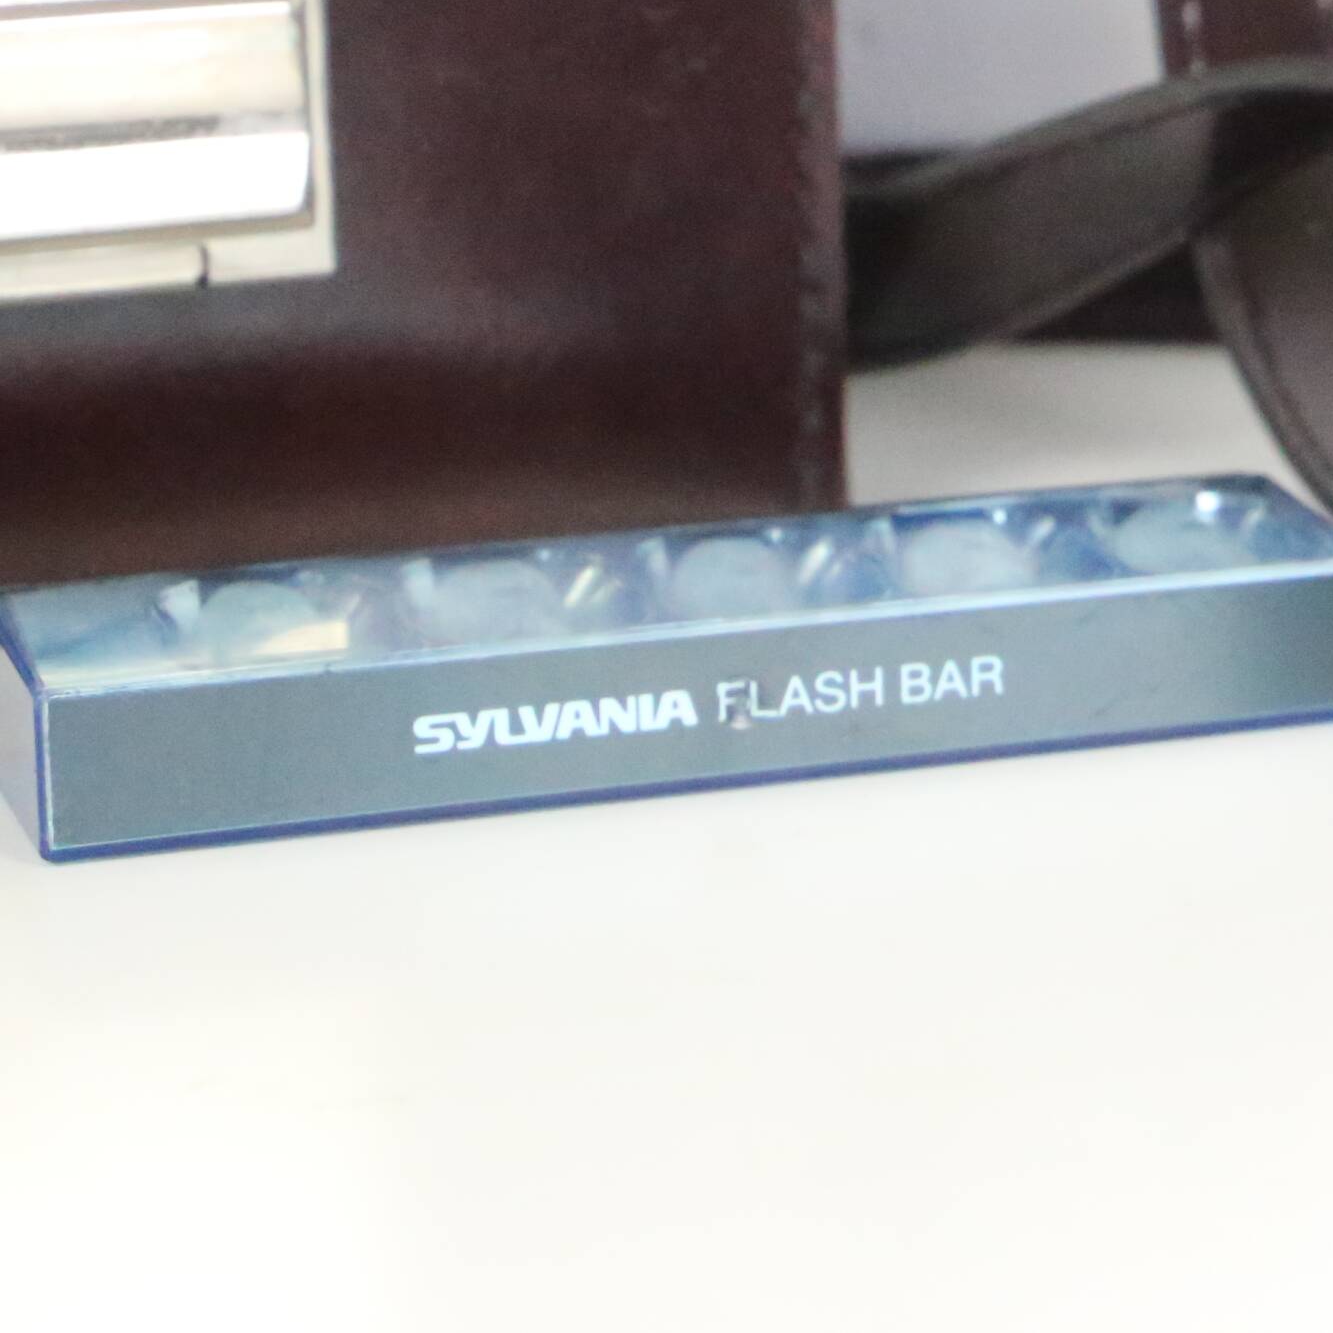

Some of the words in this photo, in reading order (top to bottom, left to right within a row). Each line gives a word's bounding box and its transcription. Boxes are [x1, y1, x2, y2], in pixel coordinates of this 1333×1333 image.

[413, 690, 698, 755] SYLVANIA
[716, 669, 884, 721] FLASH
[900, 655, 1005, 704] BAR
